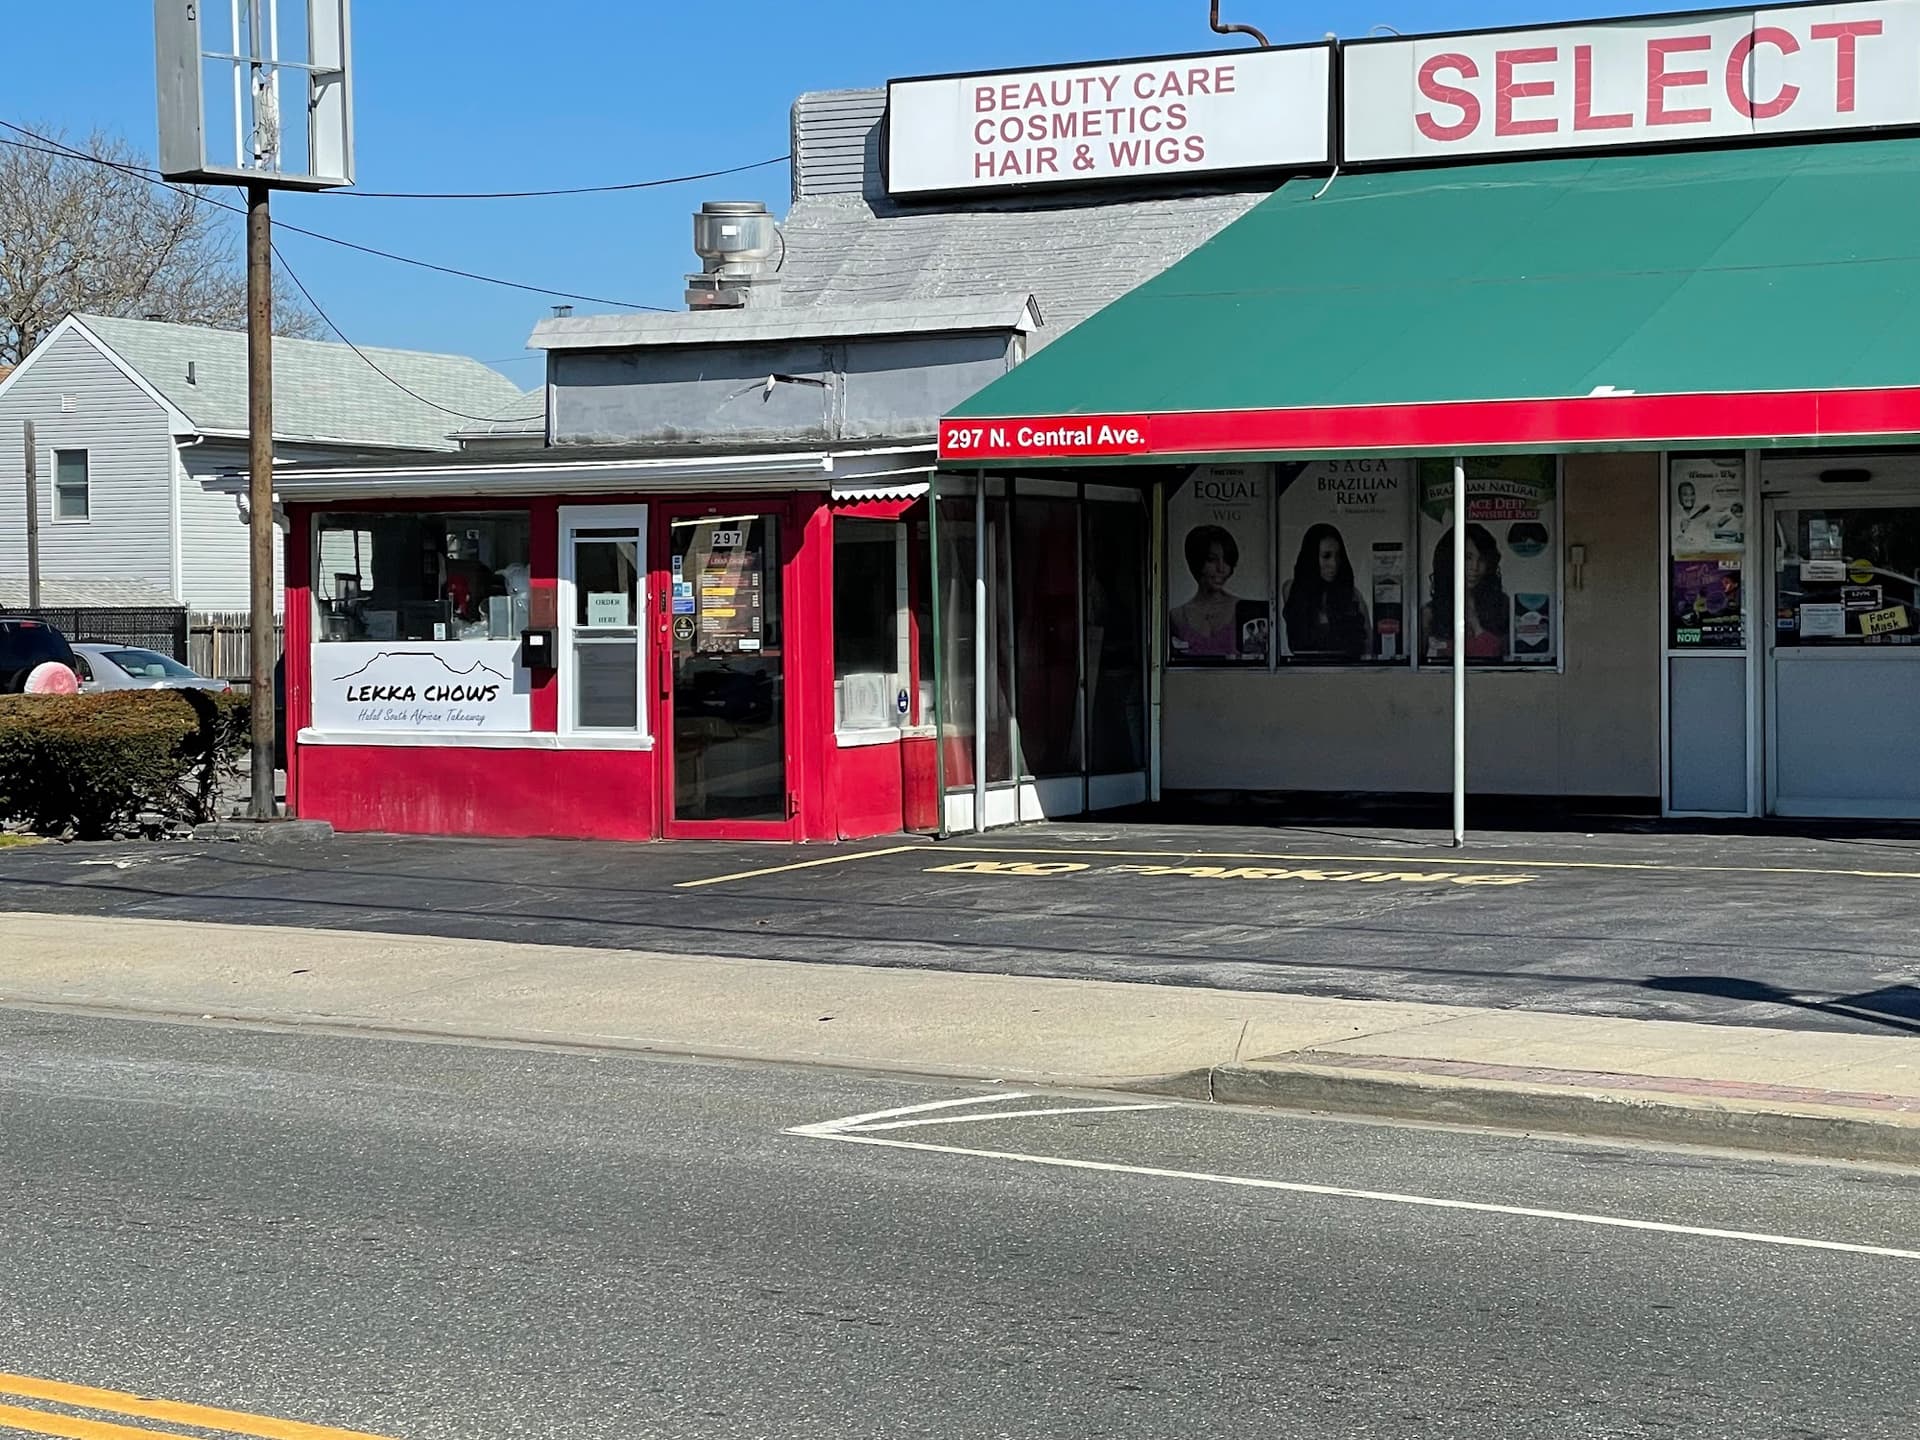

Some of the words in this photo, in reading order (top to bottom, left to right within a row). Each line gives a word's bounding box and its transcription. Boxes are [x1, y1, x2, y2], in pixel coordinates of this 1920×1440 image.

[975, 75, 1121, 113] BEAUTY
[1133, 65, 1235, 99] CARE
[1414, 19, 1883, 142] SELECT
[974, 103, 1188, 145] COSMETICS
[974, 146, 1059, 178] HAIR
[1072, 144, 1096, 170] &
[1109, 135, 1205, 168] WIGS
[947, 429, 983, 448] 297
[990, 428, 1011, 447] N.
[1017, 426, 1092, 447] Central
[1097, 425, 1146, 445] Ave.
[1194, 480, 1260, 502] EQUAL
[1317, 477, 1399, 491] BRAZILIAN
[1336, 491, 1378, 505] REMY
[712, 532, 742, 545] 297
[1868, 611, 1897, 623] Face
[1870, 621, 1901, 635] Mask
[1677, 634, 1701, 643] NOW
[346, 685, 417, 701] LEKKA
[424, 684, 500, 701] CHOWS
[384, 708, 407, 721] South
[409, 708, 441, 725] African
[445, 708, 486, 726] Takeaway
[922, 861, 1091, 875] NO
[1090, 864, 1541, 885] PARKING
